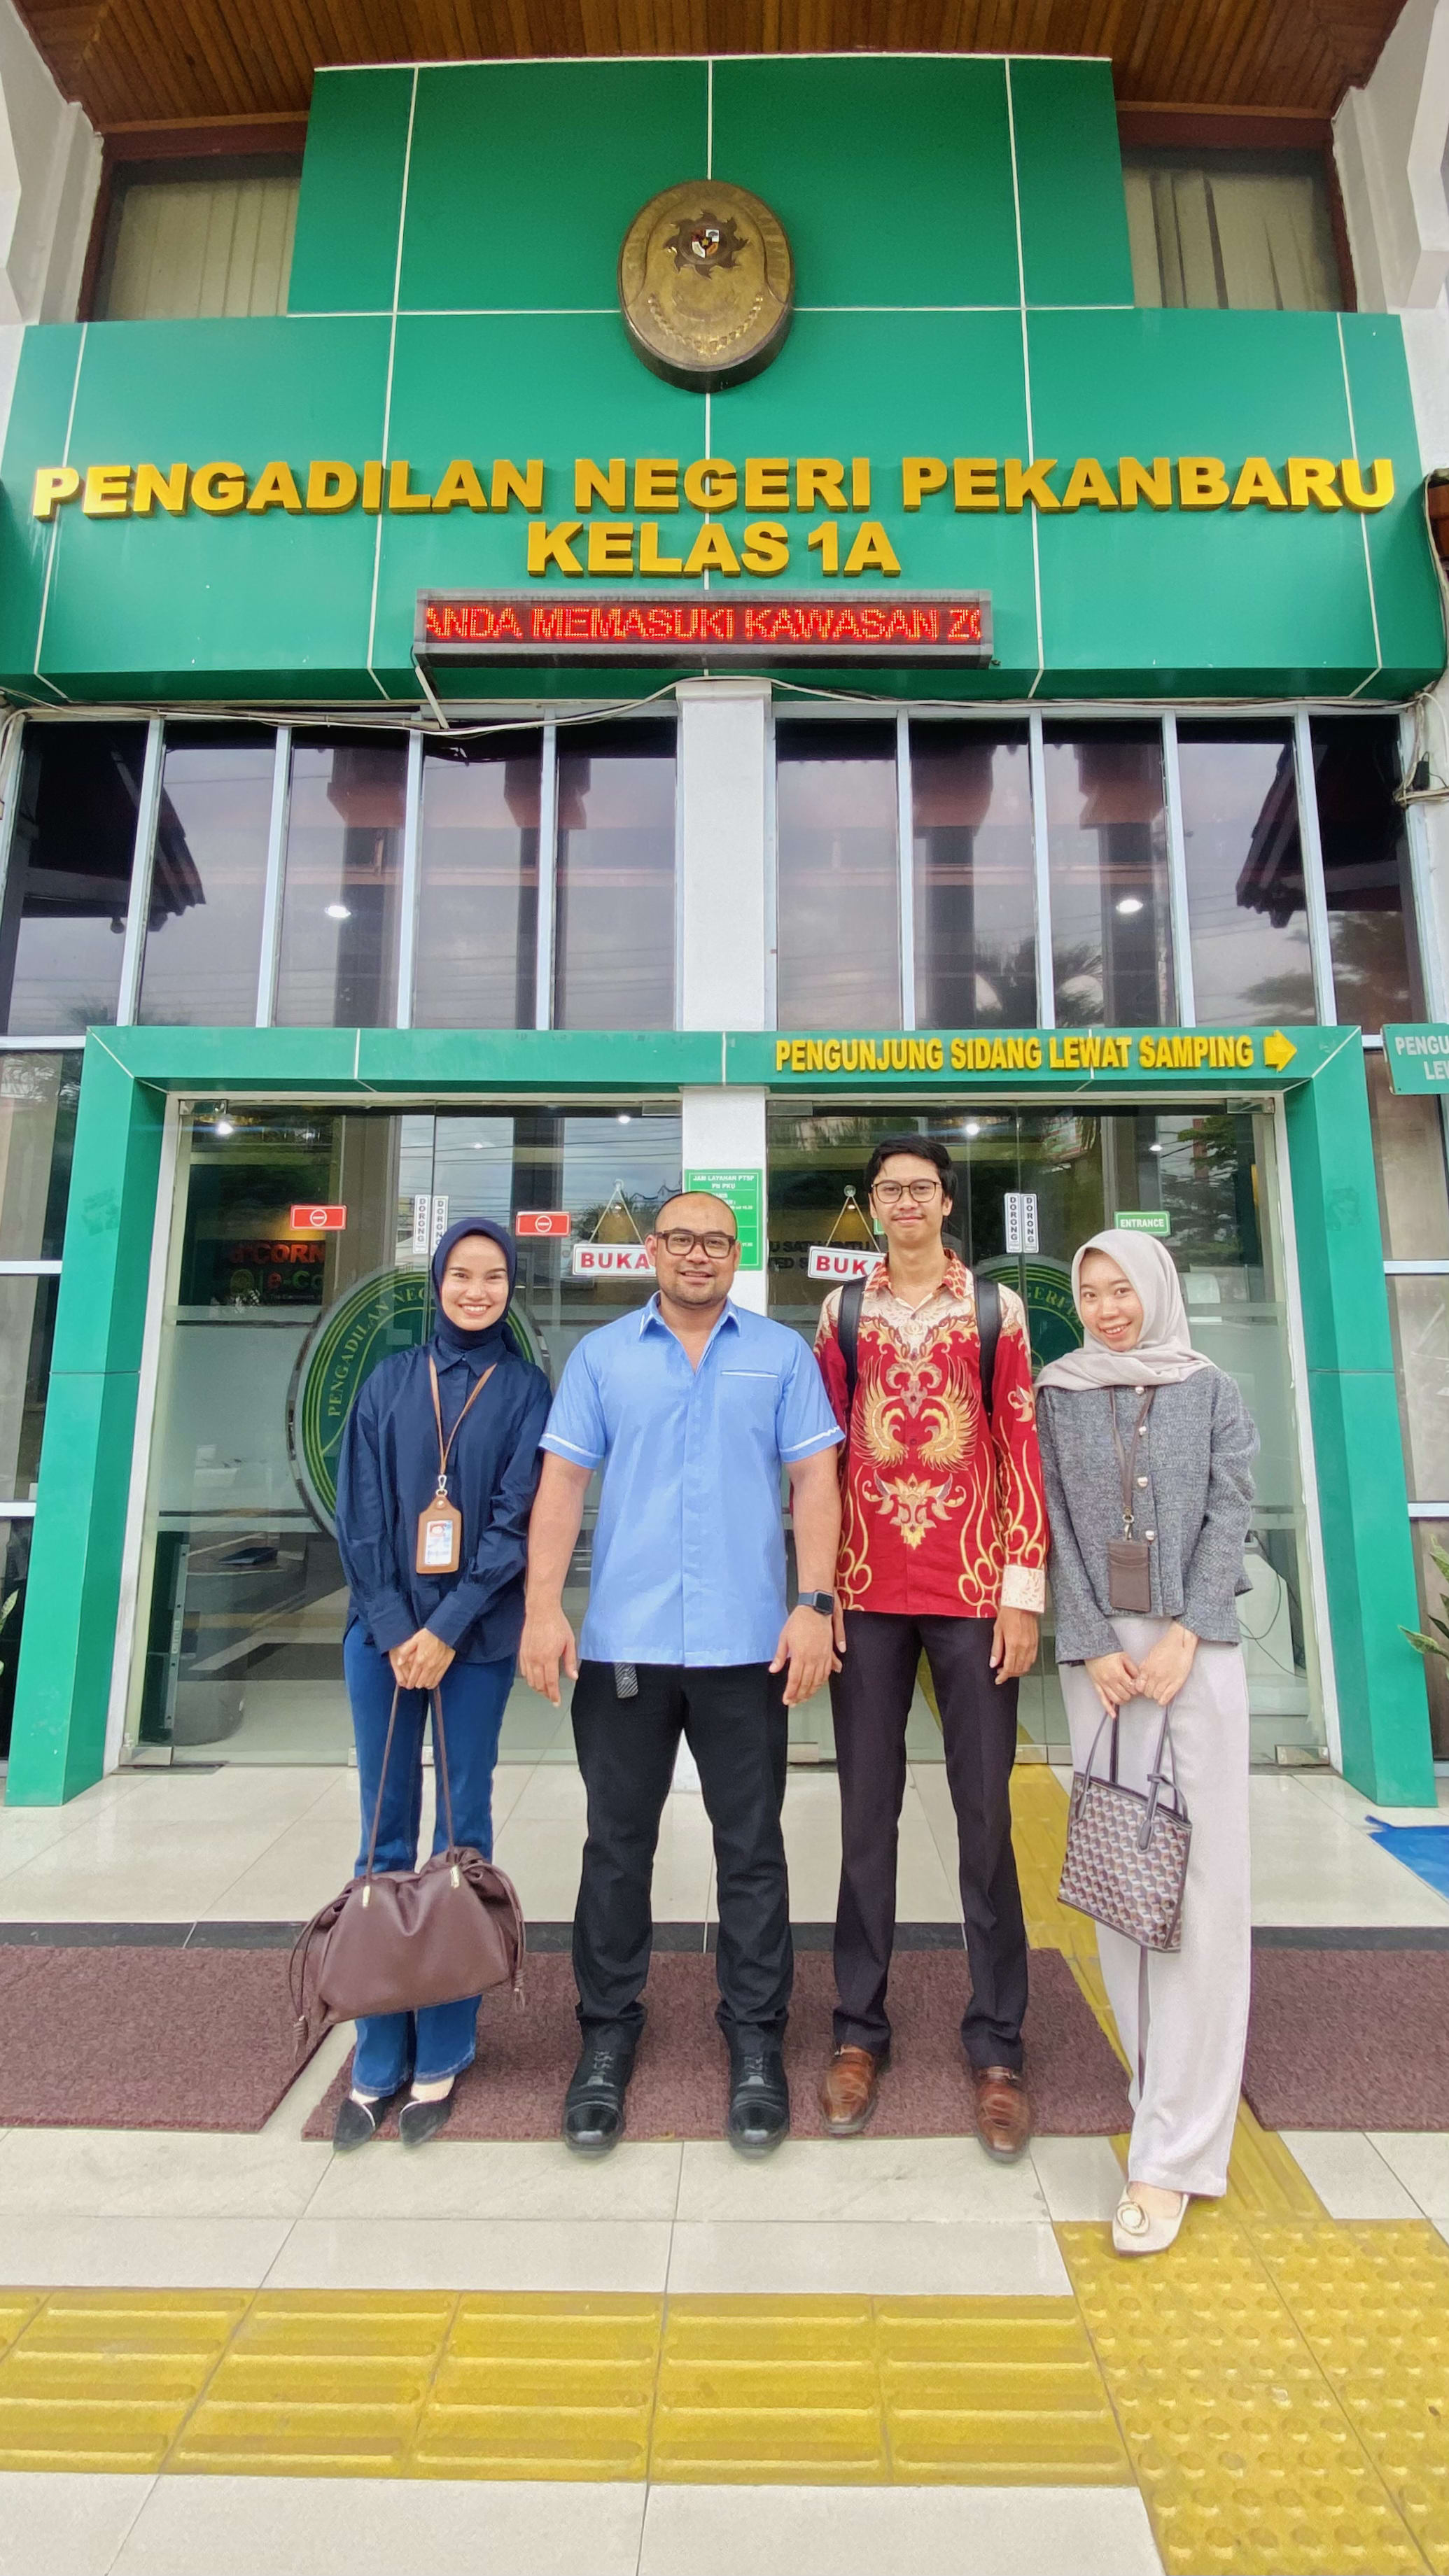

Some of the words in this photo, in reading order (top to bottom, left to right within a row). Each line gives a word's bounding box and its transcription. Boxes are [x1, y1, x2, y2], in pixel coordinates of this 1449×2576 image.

[32, 460, 544, 521] PENGADILAN
[575, 458, 869, 514] NEGERI
[903, 457, 1395, 514] PEKANBARU
[526, 521, 789, 579] KELAS
[807, 521, 902, 578] 1A
[532, 606, 734, 640] MEMASUKI
[744, 607, 940, 640] KAWASAN
[776, 1039, 943, 1072] PENGUNJUNG
[951, 1038, 1043, 1071] SIDANG
[1049, 1038, 1132, 1069] LEWAT
[1138, 1036, 1254, 1069] SAMPING
[418, 1198, 426, 1242] DORONG
[1026, 1197, 1035, 1243] DORONG
[1120, 1218, 1165, 1228] ENTRANCE
[580, 1252, 650, 1269] BUKA
[328, 1304, 389, 1416] PENGADILAN
